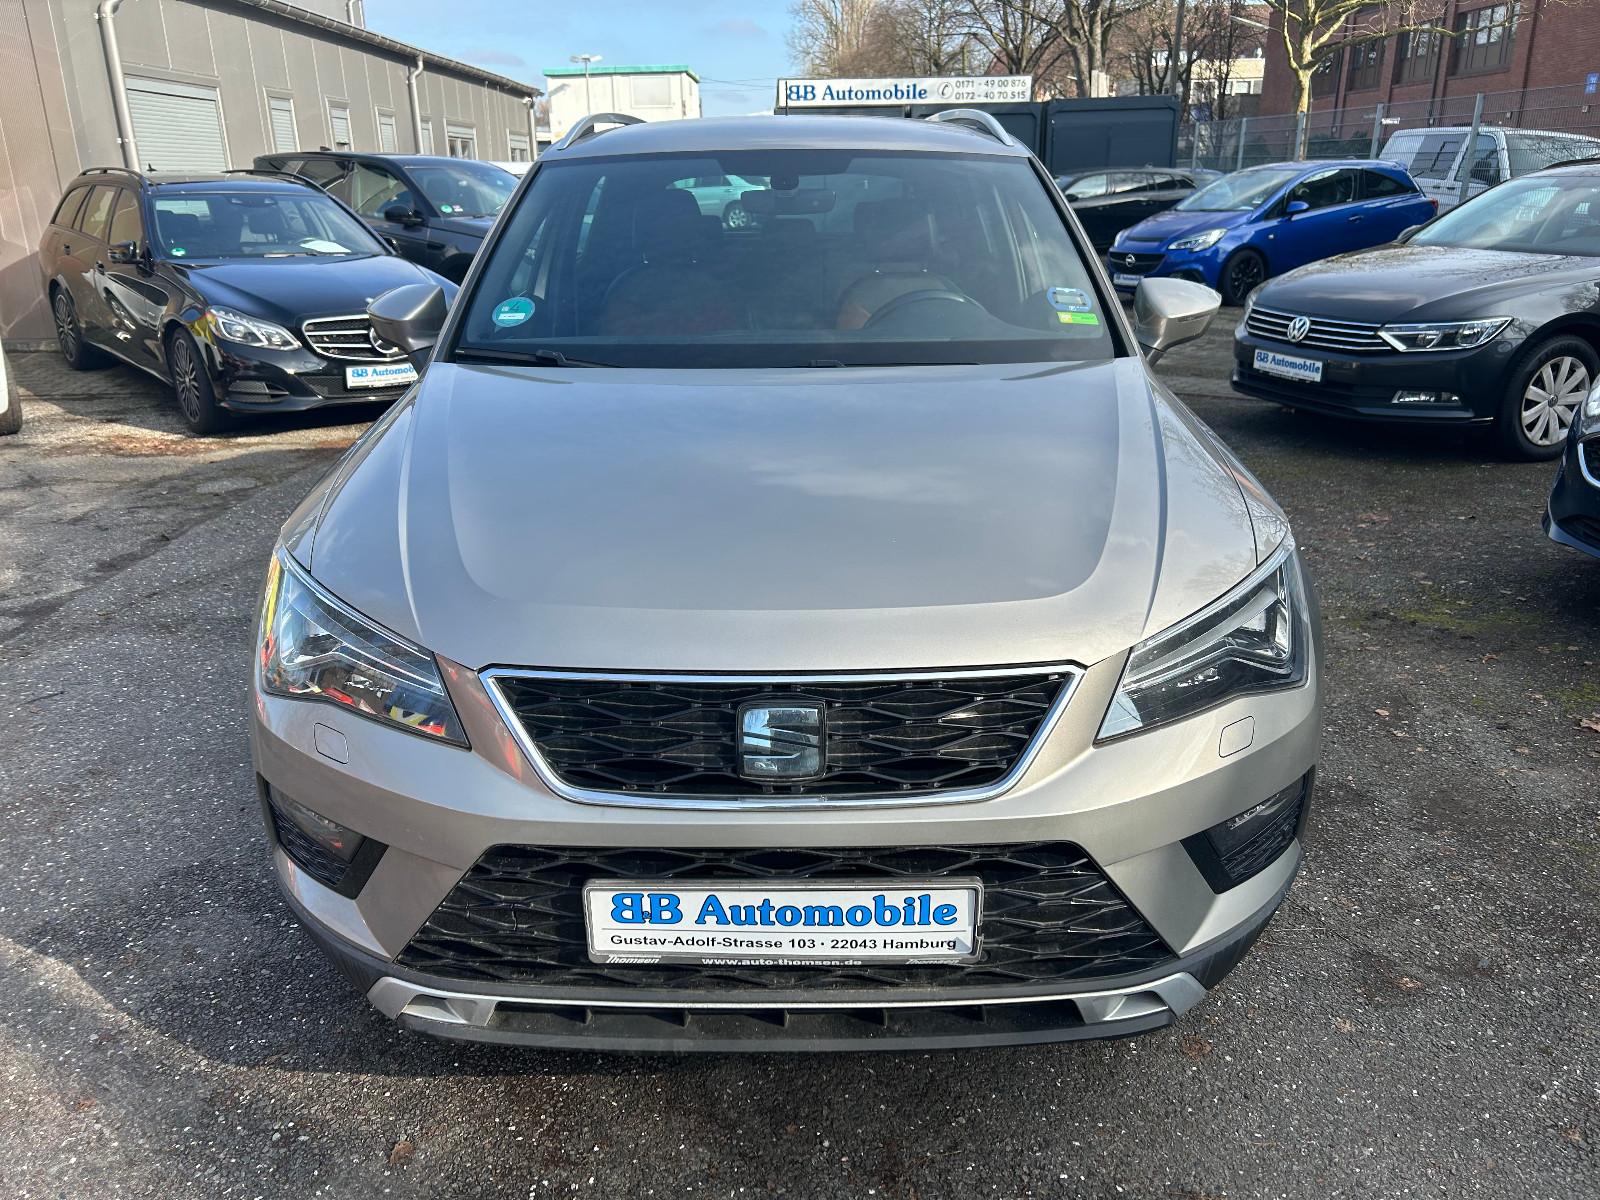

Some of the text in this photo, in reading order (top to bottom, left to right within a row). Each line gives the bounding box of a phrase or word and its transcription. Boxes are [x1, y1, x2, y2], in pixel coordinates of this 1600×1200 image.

[822, 83, 927, 101] Automobile
[955, 80, 975, 89] 0171
[984, 79, 995, 88] 49
[997, 79, 1009, 88] 00
[955, 91, 975, 100] 0172
[984, 91, 995, 100] 40
[997, 91, 1009, 100] 70
[1270, 355, 1321, 374] Automobile
[610, 893, 958, 927] B&B Automobile
[610, 935, 783, 949] Gustav-Adolf-Strasse
[788, 938, 816, 949] 103
[830, 938, 877, 950] 22043
[883, 938, 957, 951] Hamburg
[701, 957, 862, 966] www.auto-thomsen.de
